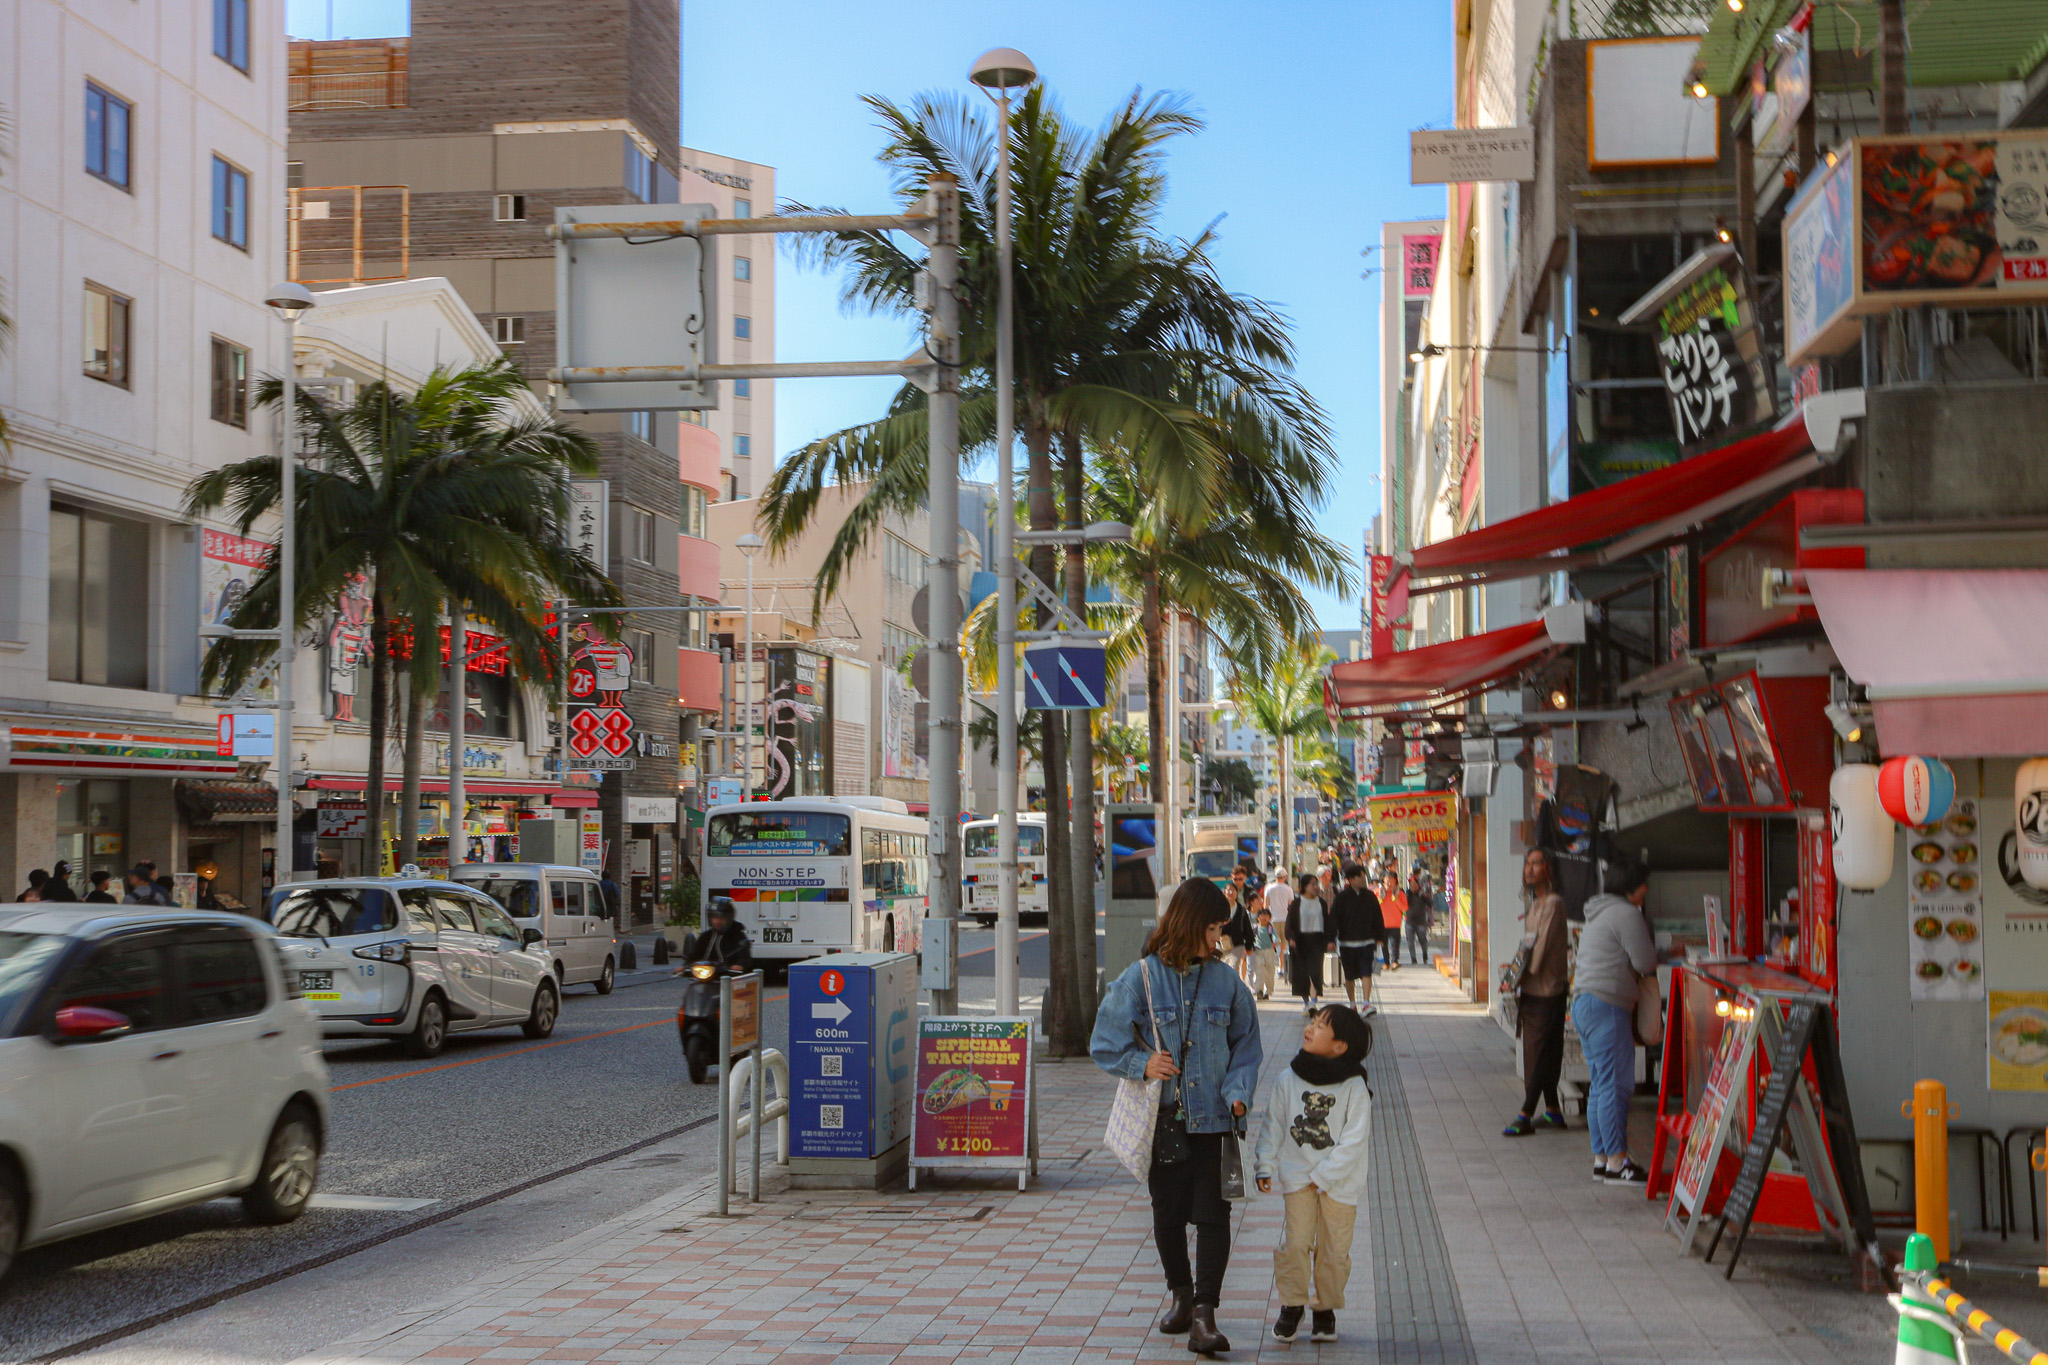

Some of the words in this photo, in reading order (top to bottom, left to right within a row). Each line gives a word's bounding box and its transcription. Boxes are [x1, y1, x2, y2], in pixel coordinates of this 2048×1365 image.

[1412, 142, 1459, 156] FIRST
[1466, 138, 1530, 153] STREET
[573, 672, 593, 694] 2F
[570, 708, 634, 759] 88
[738, 867, 817, 878] NON-STEP
[358, 965, 375, 977] 18
[815, 1028, 849, 1039] 600m
[935, 1038, 1012, 1052] SPECIAL
[926, 1052, 1021, 1066] TACOSSET
